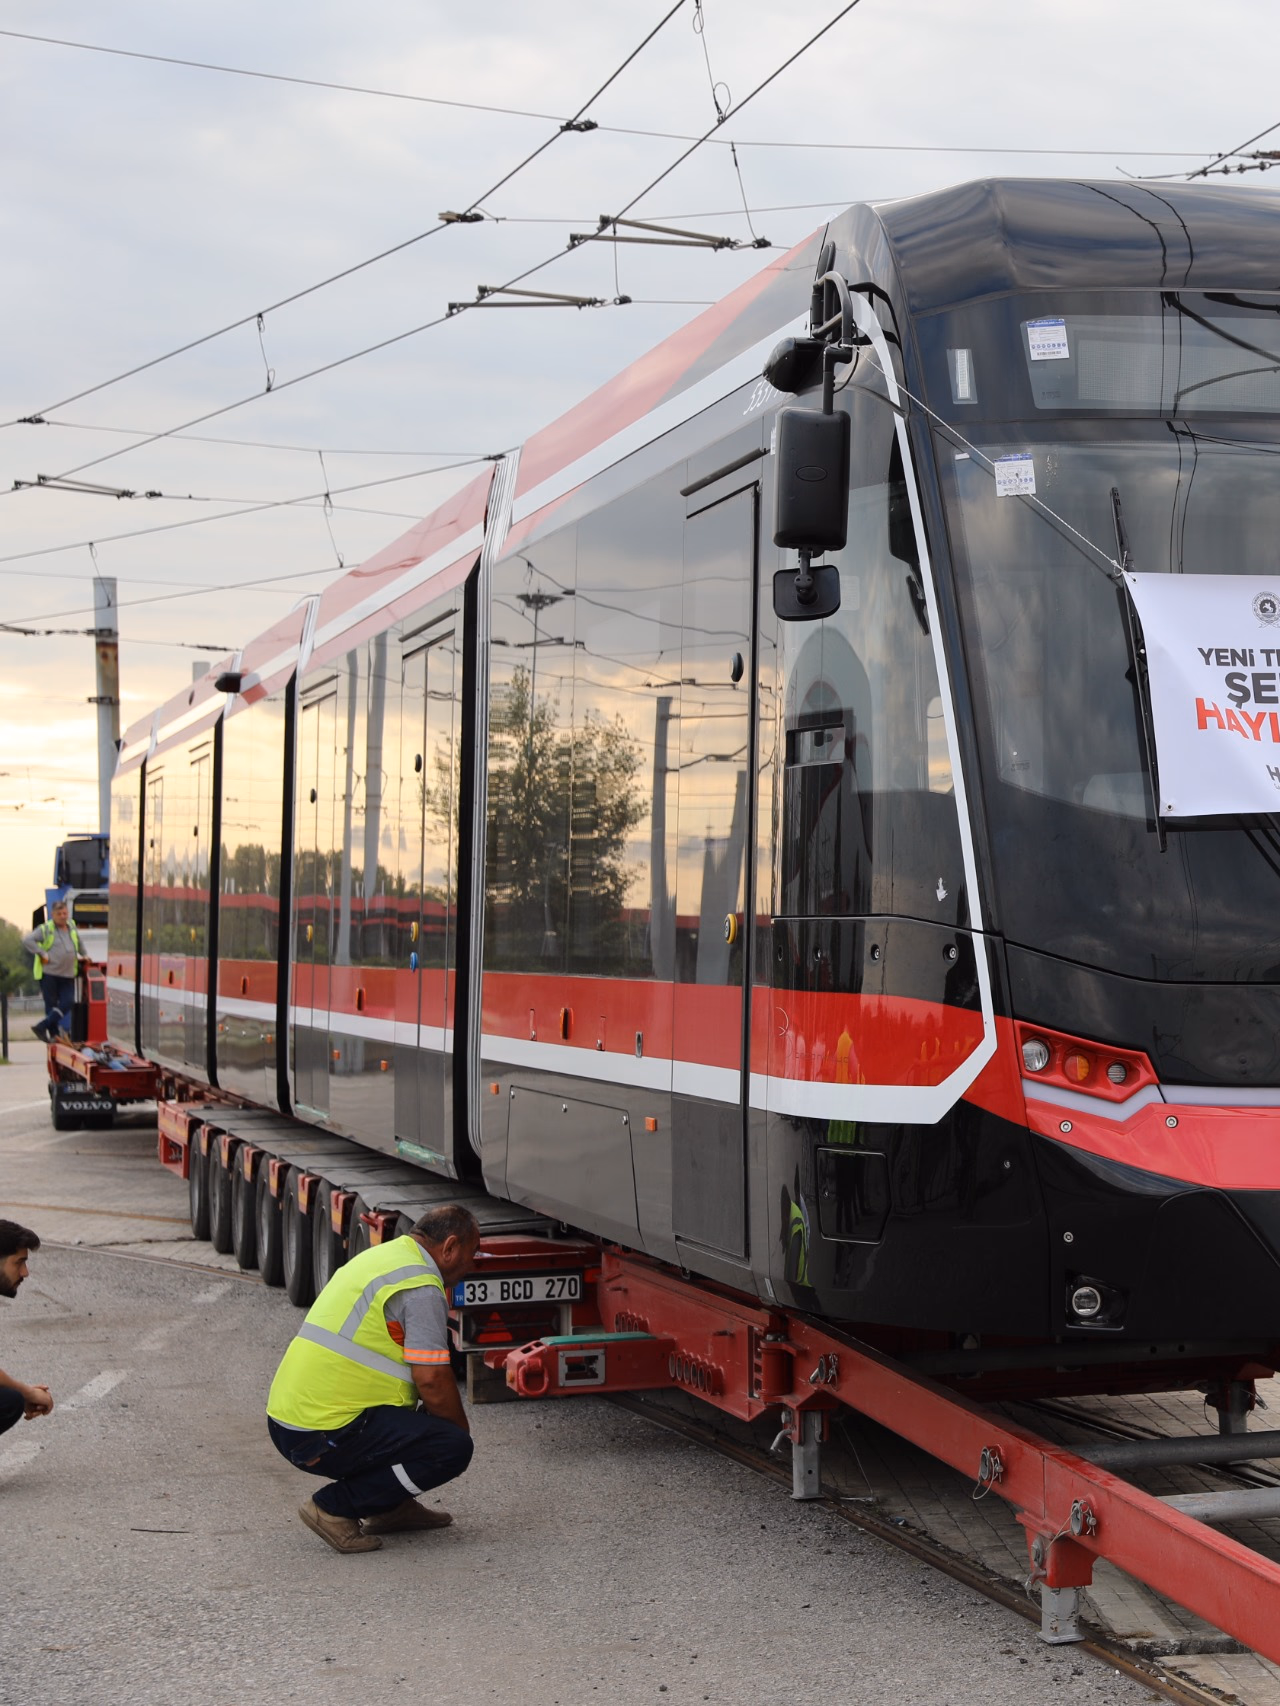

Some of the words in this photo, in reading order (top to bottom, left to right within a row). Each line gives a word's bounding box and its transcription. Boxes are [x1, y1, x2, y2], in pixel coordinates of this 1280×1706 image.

[1197, 647, 1255, 668] YENİ
[60, 1101, 113, 1111] VOLVO
[455, 1294, 464, 1302] TR
[465, 1283, 488, 1303] 33
[500, 1280, 533, 1301] BCD
[545, 1277, 578, 1298] 270
